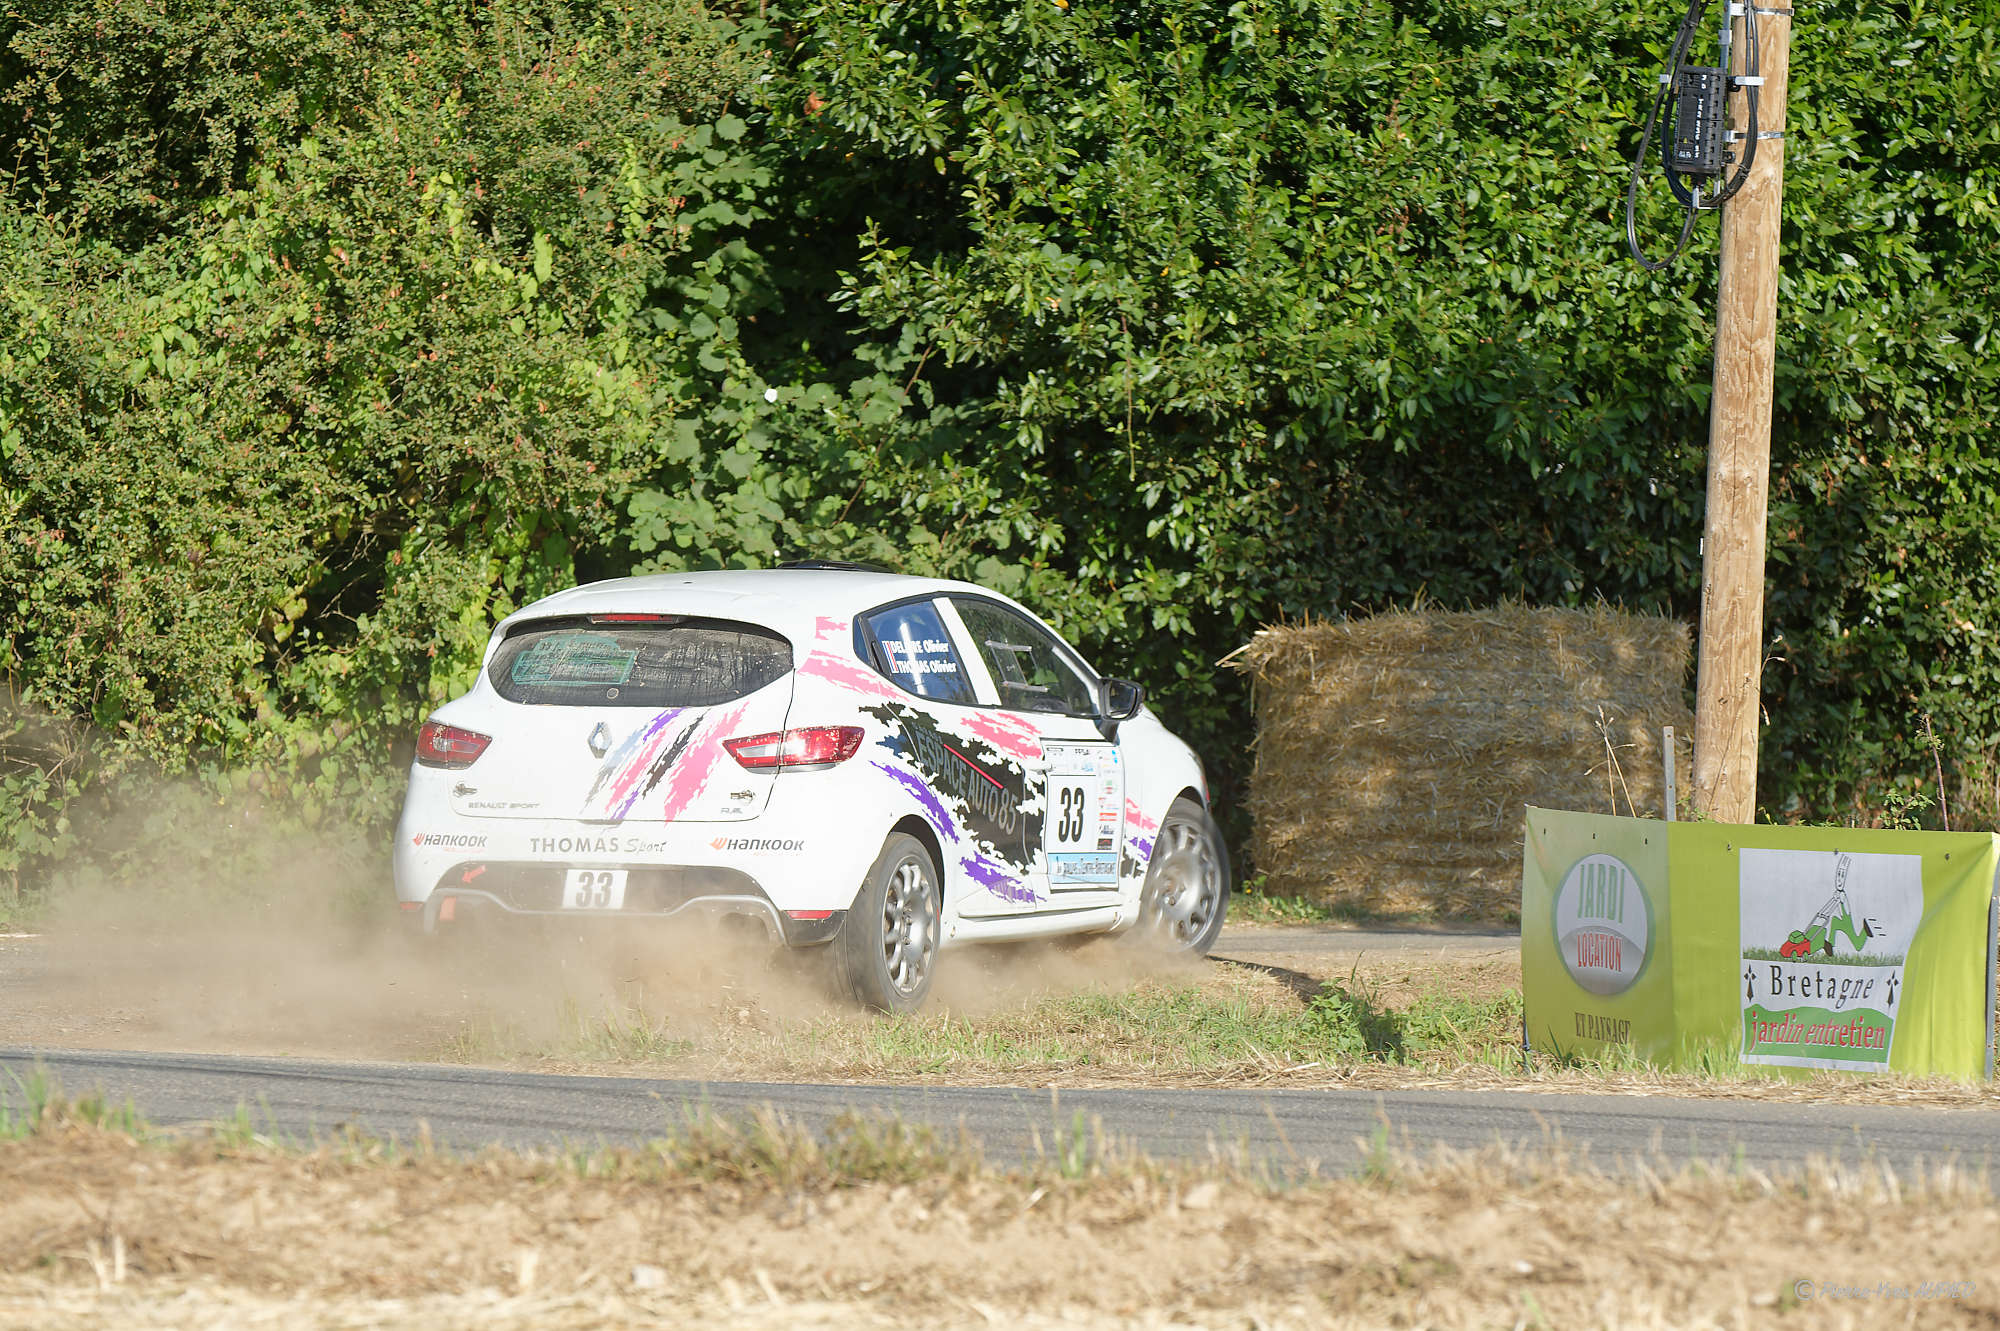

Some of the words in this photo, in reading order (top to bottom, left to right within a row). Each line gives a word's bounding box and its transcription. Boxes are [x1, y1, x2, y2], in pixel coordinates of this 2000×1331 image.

[1058, 786, 1085, 843] 33
[530, 837, 618, 853] THOMAS
[624, 837, 667, 854] Sport
[575, 870, 614, 909] 33
[1577, 863, 1626, 924] JARDI
[1577, 932, 1623, 973] LOCATION
[1769, 964, 1874, 1009] Bretagne
[1575, 1011, 1586, 1038] ET
[1750, 1010, 1804, 1052] jardin
[1804, 1015, 1885, 1050] entretien
